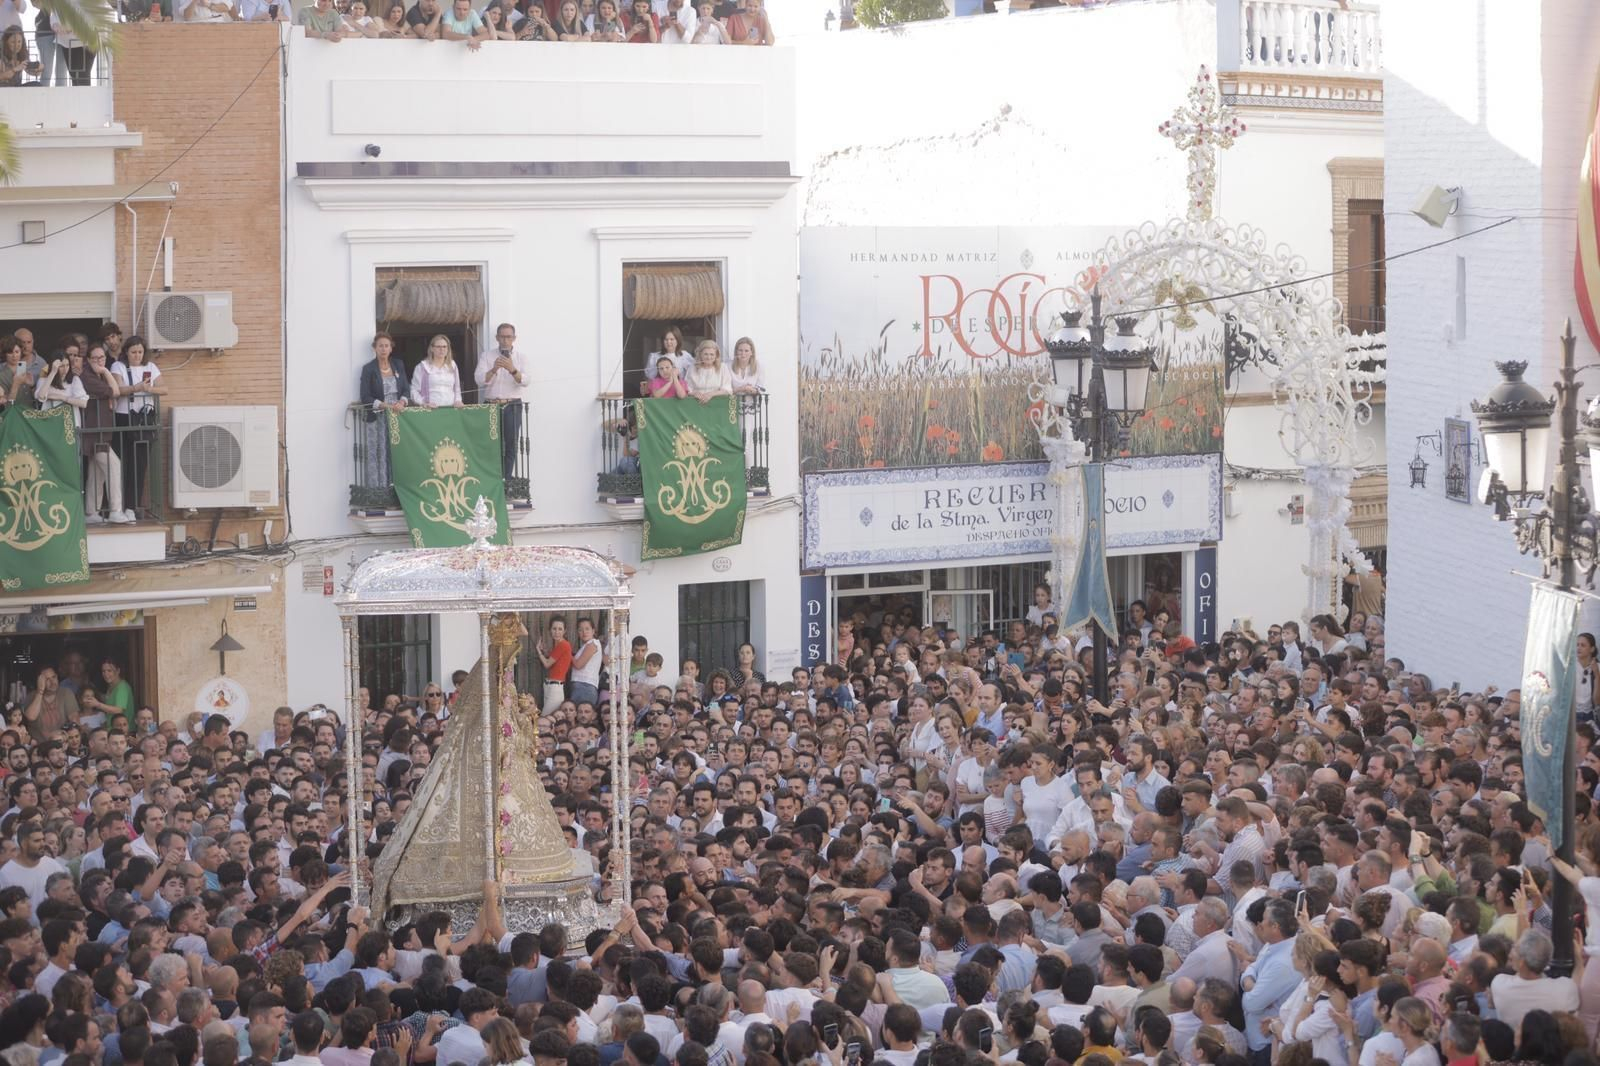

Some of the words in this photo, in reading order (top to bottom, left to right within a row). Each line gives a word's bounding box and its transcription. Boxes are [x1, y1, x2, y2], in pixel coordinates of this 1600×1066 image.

[850, 252, 938, 262] HERMANDAD
[946, 252, 997, 262] MATRIZ
[808, 382, 906, 393] VOLVEREMOS
[930, 378, 1027, 389] ABRAZARNOS
[924, 482, 1059, 509] RECUER
[1104, 495, 1147, 515] OCIO
[891, 515, 910, 531] de
[917, 513, 933, 529] la
[940, 510, 990, 532] Stma.
[998, 505, 1054, 527] Virgen
[967, 528, 1030, 543] DESPACHO
